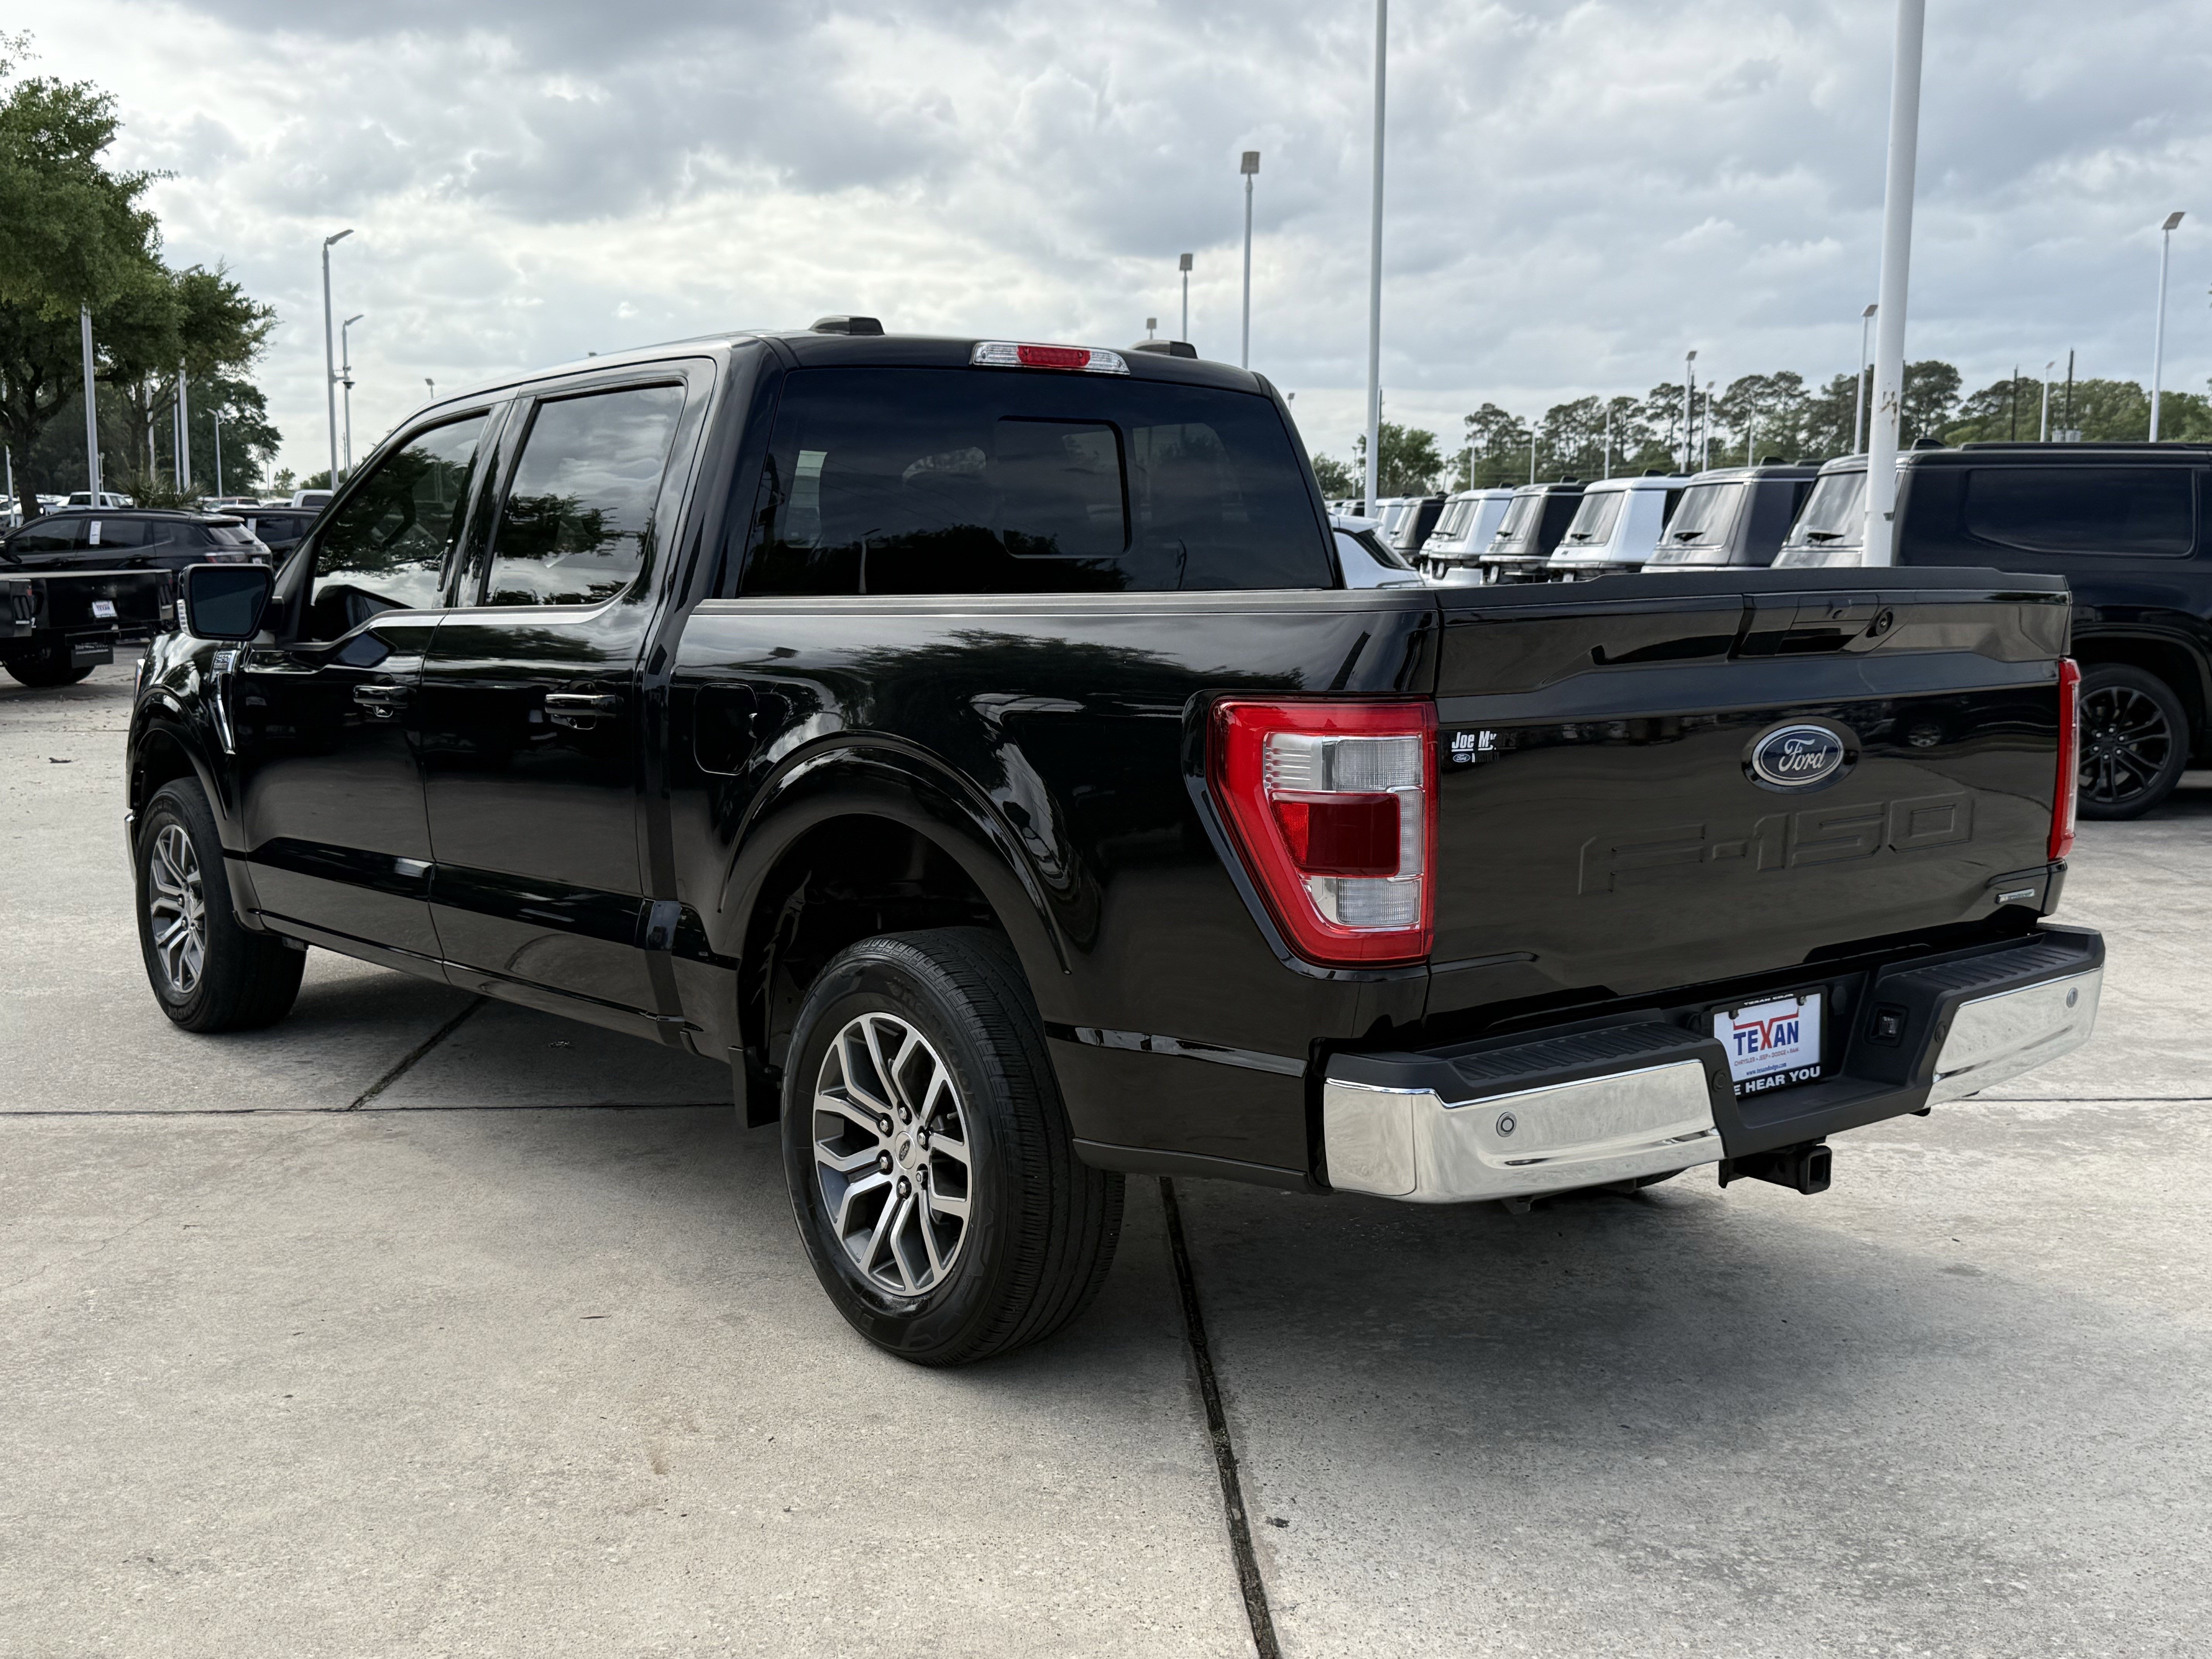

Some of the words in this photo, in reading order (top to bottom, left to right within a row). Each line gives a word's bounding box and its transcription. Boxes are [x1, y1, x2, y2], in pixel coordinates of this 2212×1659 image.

[1451, 732, 1475, 749] Joe
[1778, 738, 1827, 772] Ford
[1578, 792, 1974, 895] F-150
[1733, 1018, 1799, 1056] TEXAN
[1734, 1057, 1755, 1066] CHRYSLER
[1771, 1049, 1787, 1058] DODGE
[1734, 1085, 1741, 1096] E
[1746, 1074, 1785, 1093] HEAR
[1789, 1066, 1820, 1082] YOU
